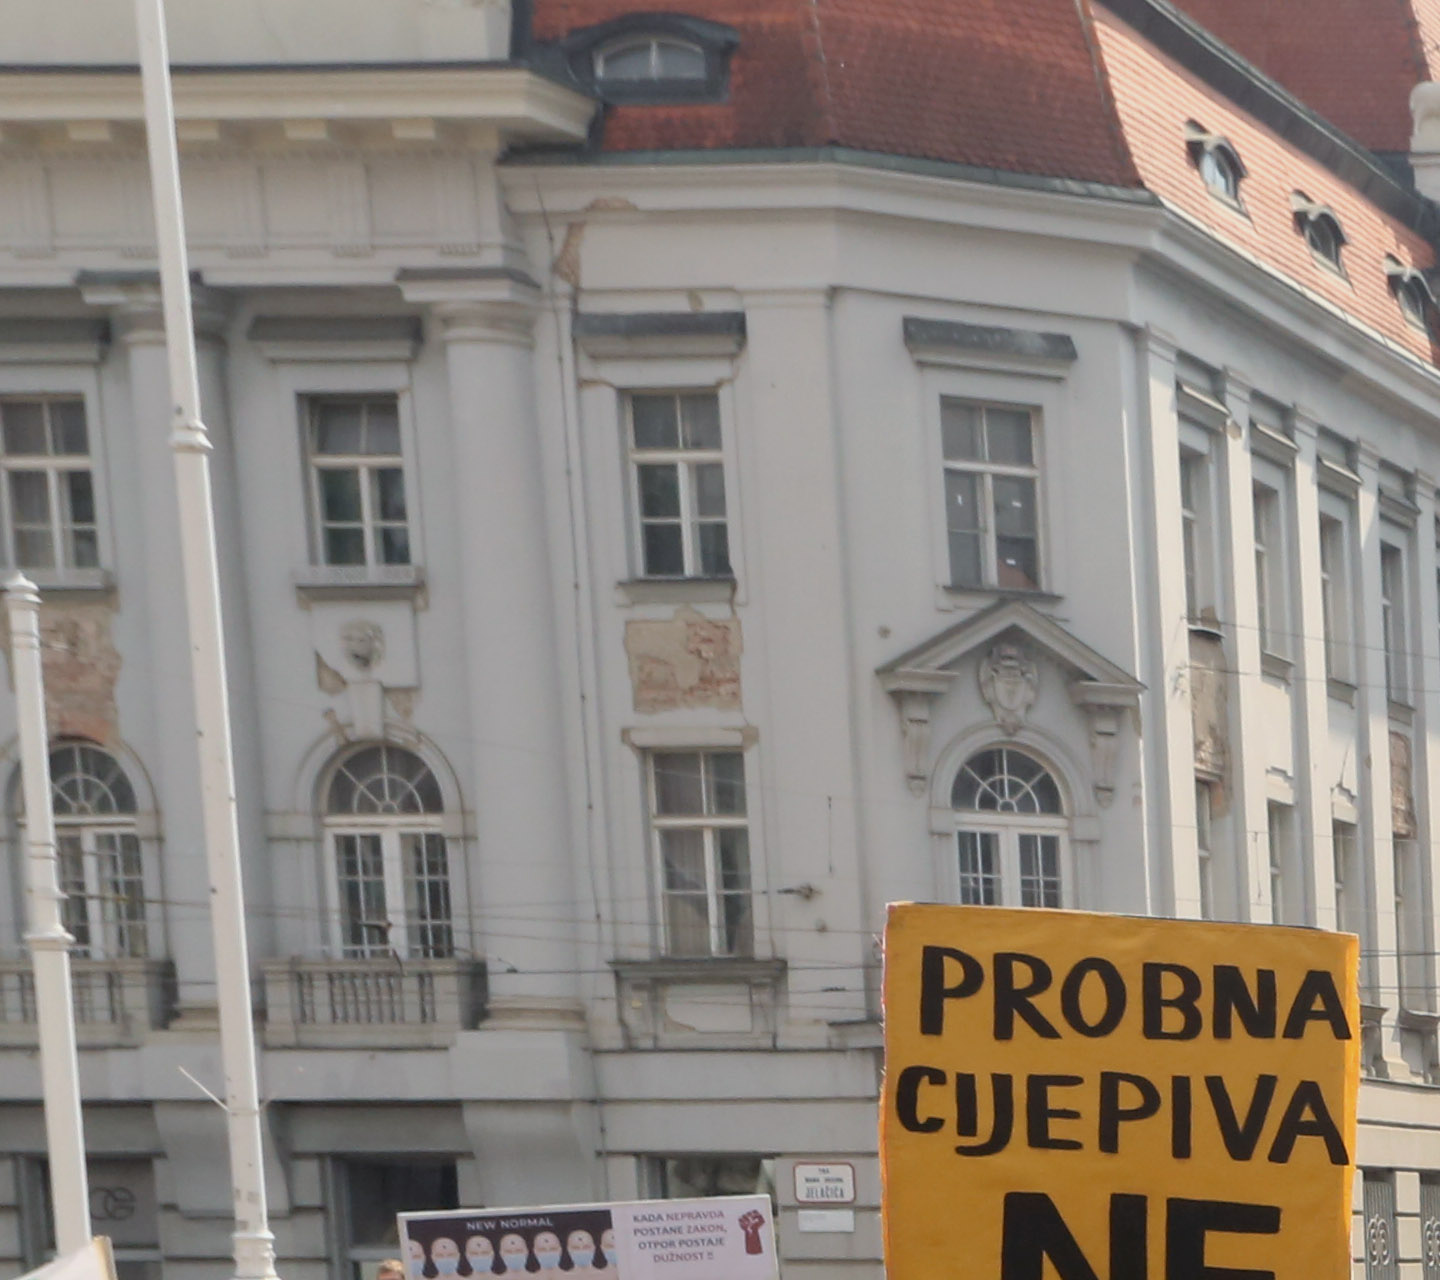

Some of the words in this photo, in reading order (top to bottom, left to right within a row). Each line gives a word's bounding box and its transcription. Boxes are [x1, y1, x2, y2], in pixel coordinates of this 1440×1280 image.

[920, 945, 1352, 1041] PROBNA
[896, 1065, 1350, 1166] CIJEPIVA
[633, 1213, 664, 1224] KADA
[666, 1209, 725, 1222] NEPRAVDA
[466, 1219, 496, 1231] NEW
[500, 1217, 553, 1230] NORMAL
[633, 1225, 684, 1237] POSTANE
[638, 1238, 677, 1250] OTPOR
[678, 1236, 725, 1248] POSTAJE
